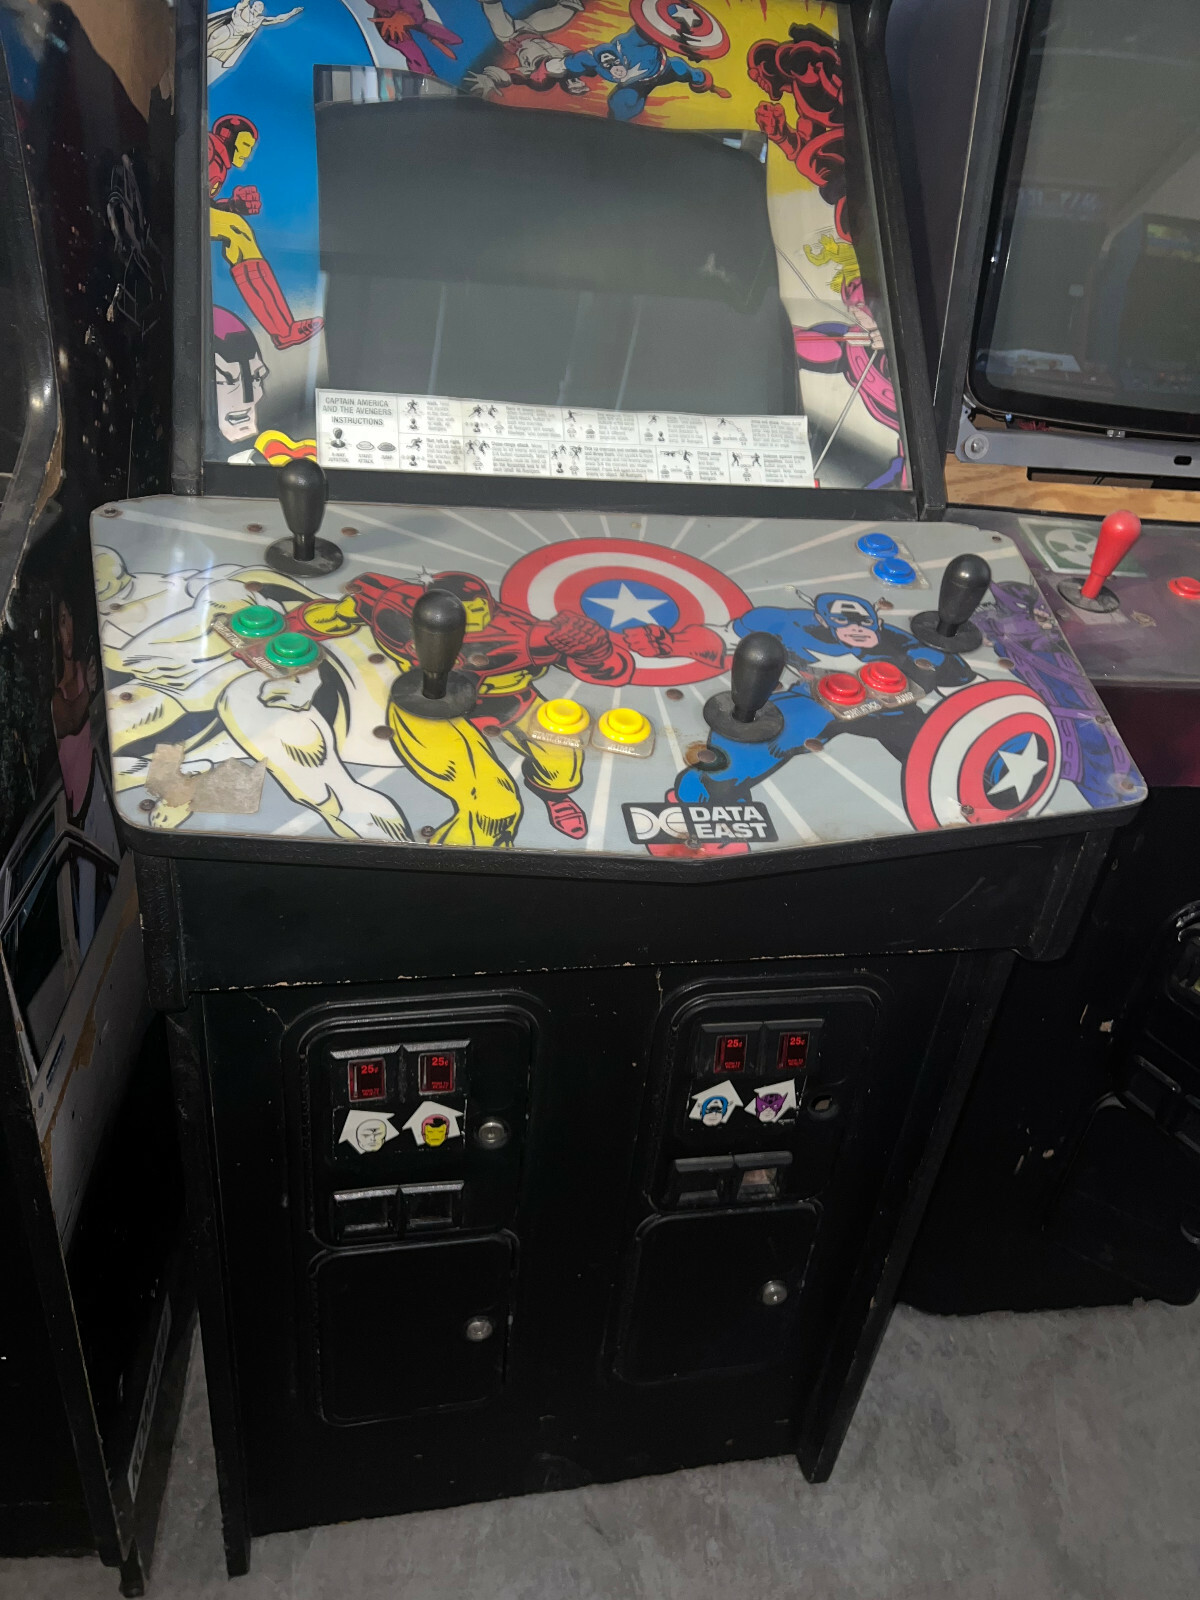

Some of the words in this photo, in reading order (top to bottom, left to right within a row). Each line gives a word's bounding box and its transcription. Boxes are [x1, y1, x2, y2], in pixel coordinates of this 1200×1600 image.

[325, 397, 355, 406] CAPTAIN
[357, 398, 389, 407] AMERICA
[322, 405, 338, 413] AND
[340, 406, 354, 414] THE
[355, 406, 392, 416] AVENGERS
[331, 415, 384, 426] INSTRUCTIONS
[688, 806, 764, 822] DATA
[693, 822, 768, 839] EAST
